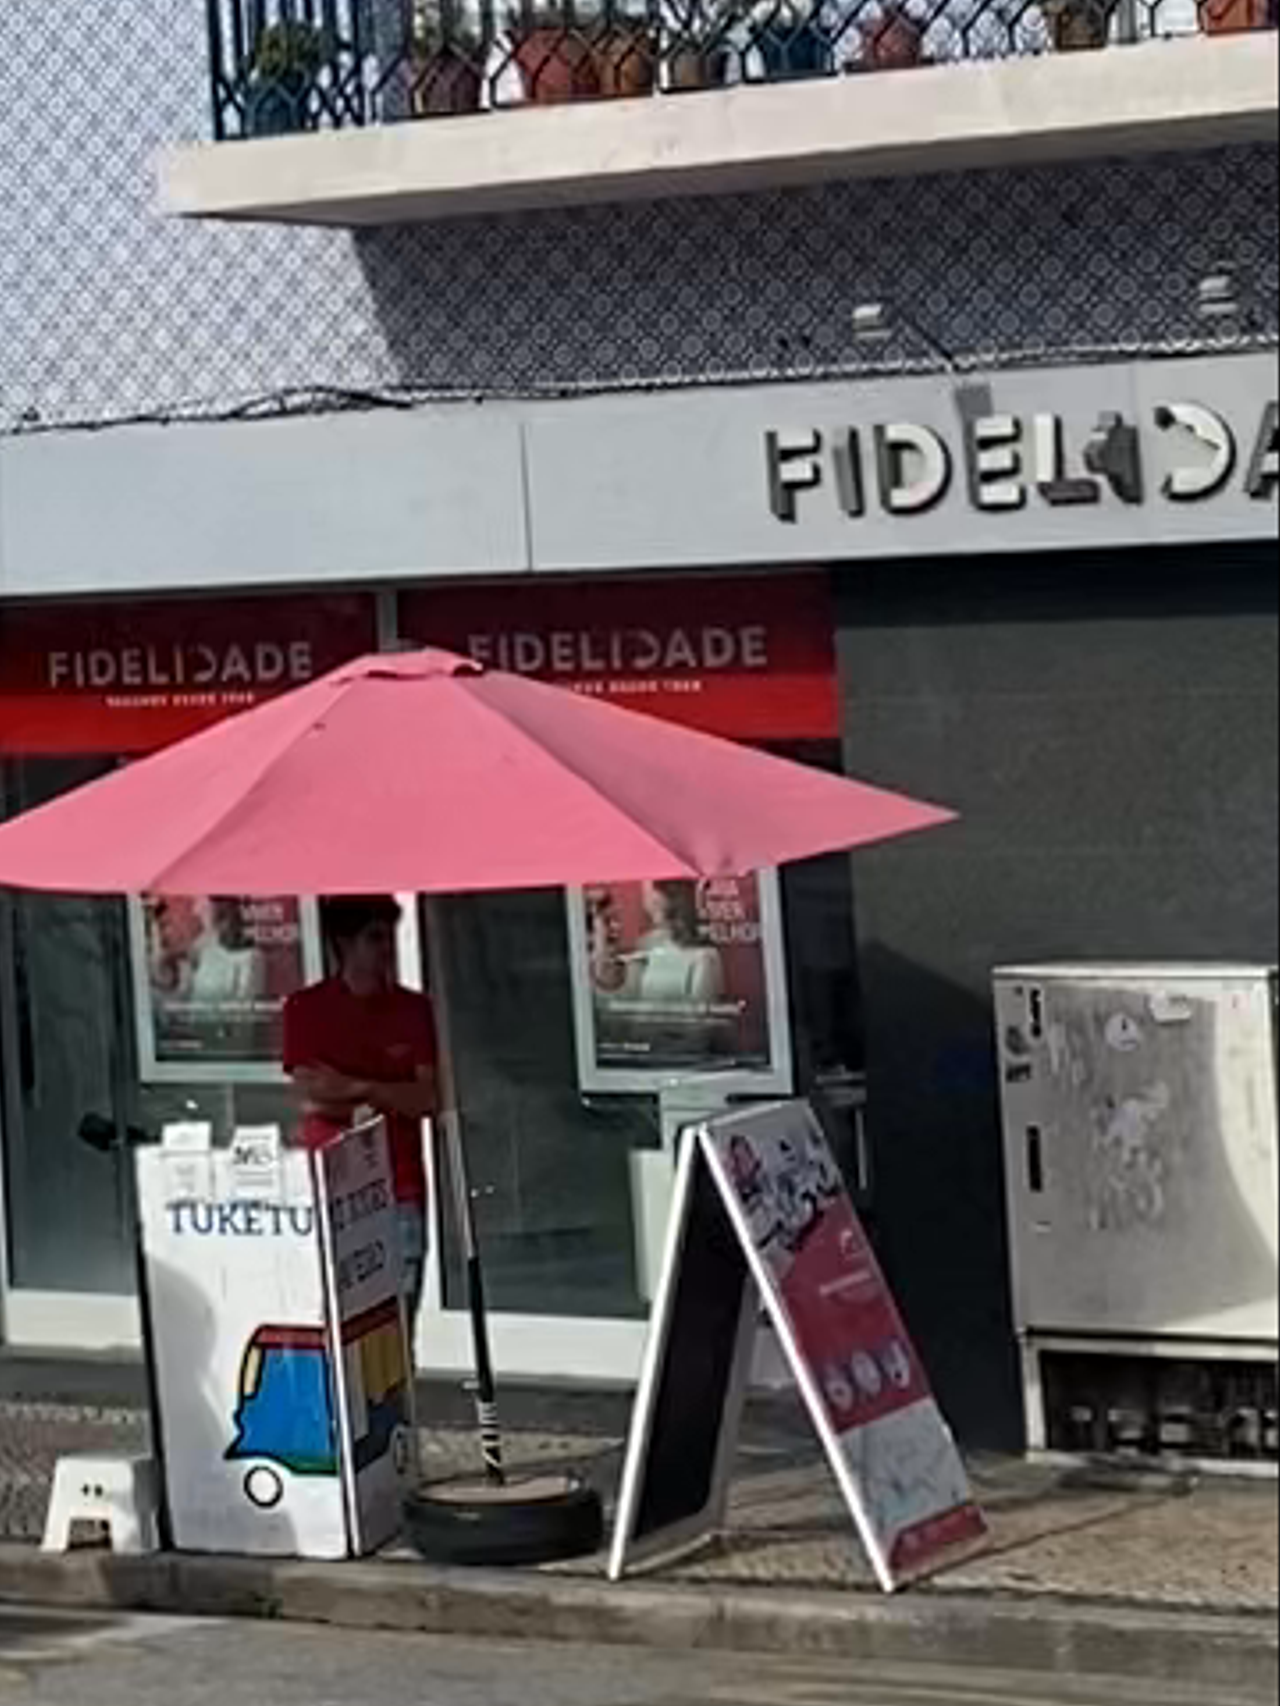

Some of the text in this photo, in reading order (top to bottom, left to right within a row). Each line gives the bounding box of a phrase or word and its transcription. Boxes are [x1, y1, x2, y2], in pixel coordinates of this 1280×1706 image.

[48, 640, 314, 689] FIDELIDADE
[467, 626, 769, 672] FIDELIDADE
[167, 1198, 313, 1236] TUKETU
